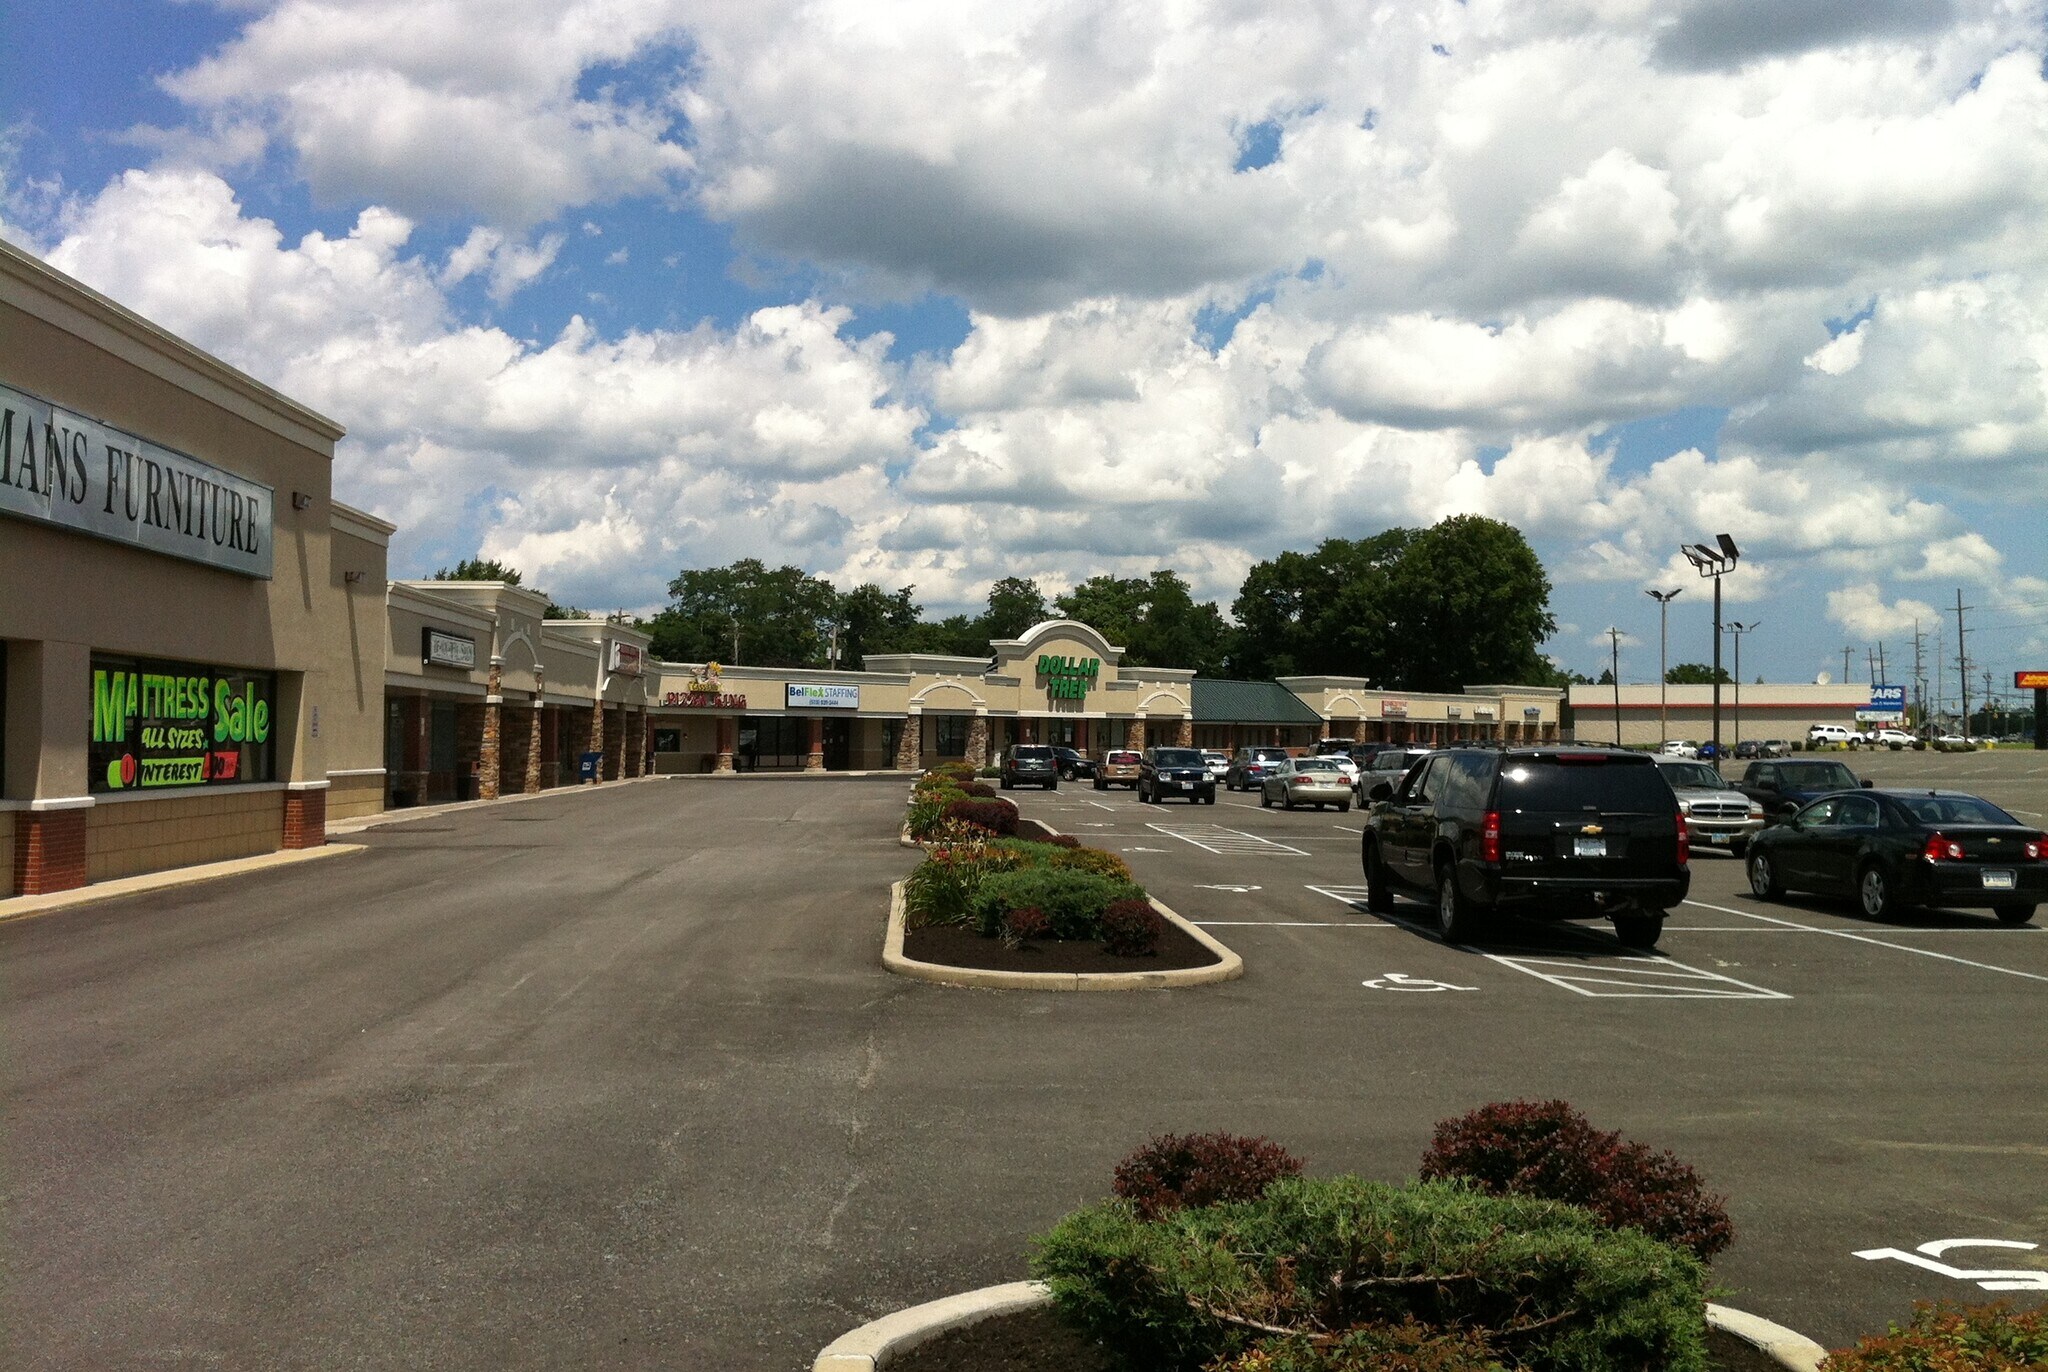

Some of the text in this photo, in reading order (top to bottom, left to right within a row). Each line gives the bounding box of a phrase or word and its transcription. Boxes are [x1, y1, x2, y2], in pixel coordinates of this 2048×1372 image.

[103, 445, 260, 555] FURNITURE
[1037, 654, 1101, 677] DOLLAR
[666, 691, 747, 709] PIZZA KING
[824, 687, 858, 699] STAFFING
[1048, 678, 1088, 700] TREE
[93, 669, 210, 743] MATTRESS
[214, 678, 270, 744] Sale
[141, 727, 204, 749] ALL SIZES
[141, 762, 202, 783] NTEREST
